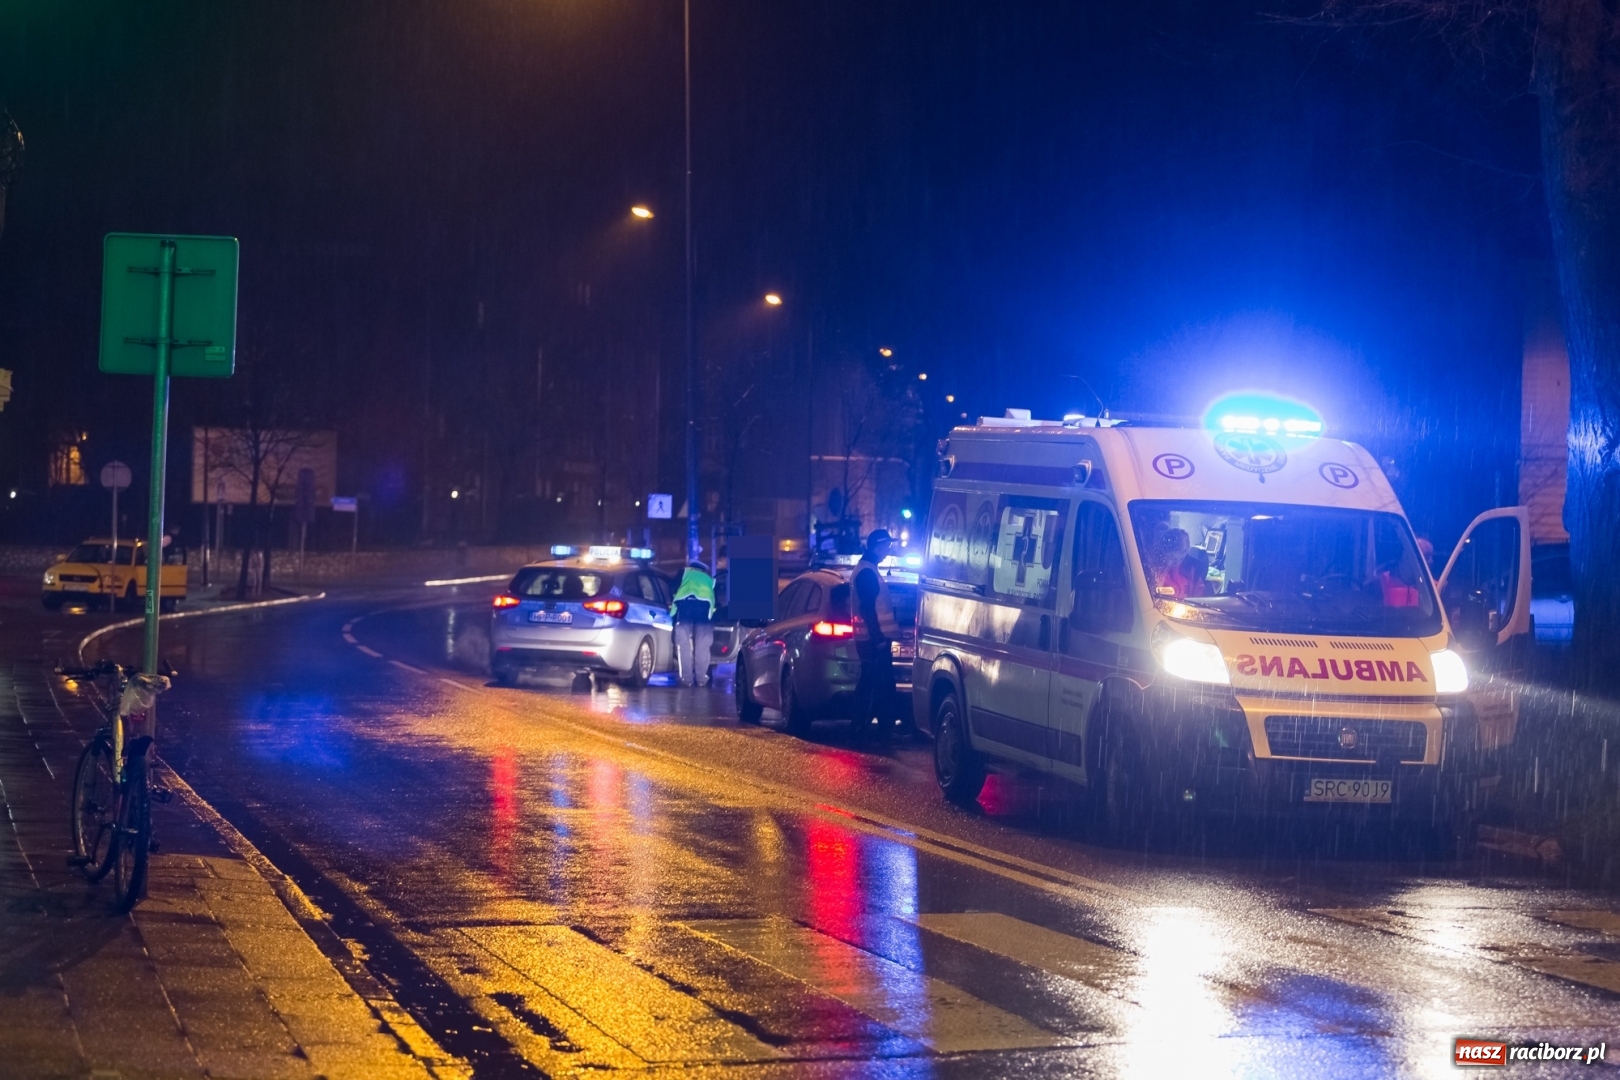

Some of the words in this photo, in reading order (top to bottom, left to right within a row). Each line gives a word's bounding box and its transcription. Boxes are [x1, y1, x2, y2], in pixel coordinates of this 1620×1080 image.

[1165, 458, 1185, 474] P
[1329, 466, 1349, 483] P
[590, 548, 619, 556] POLICJA
[1314, 780, 1347, 797] SRC
[1352, 781, 1389, 798] 90J9
